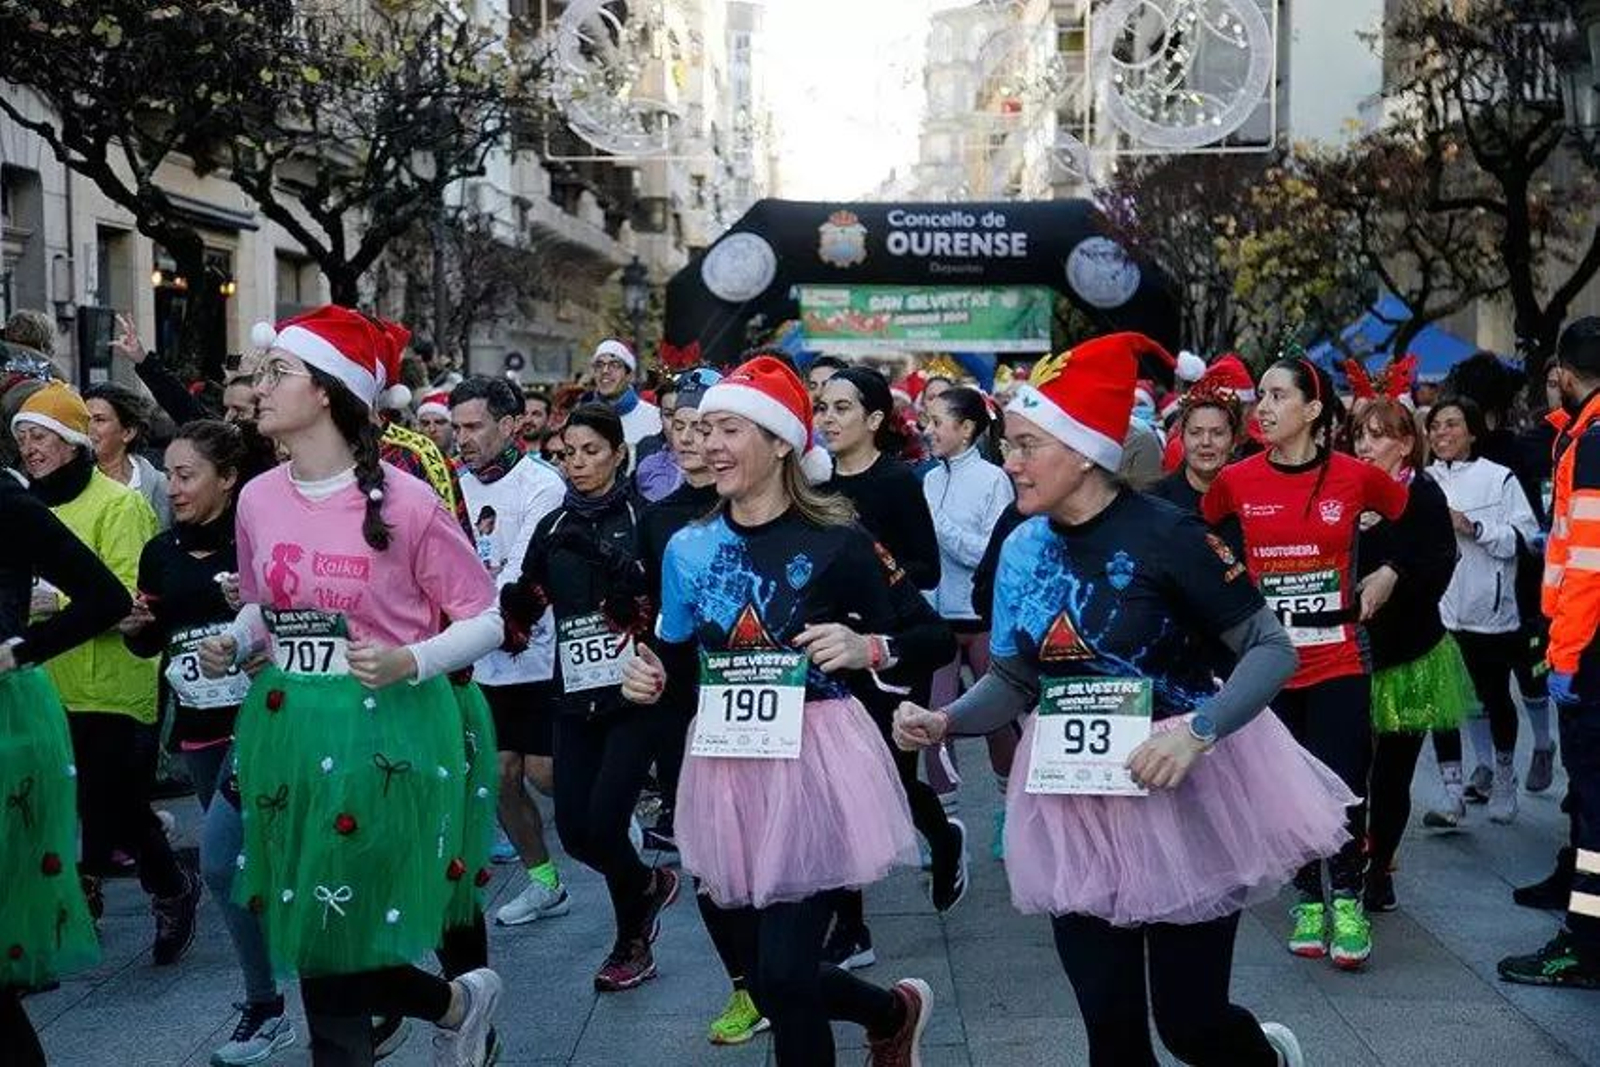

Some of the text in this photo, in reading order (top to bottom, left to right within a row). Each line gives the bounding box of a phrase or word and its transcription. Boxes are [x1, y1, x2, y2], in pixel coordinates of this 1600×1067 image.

[887, 209, 1005, 228] Concello de
[886, 232, 1028, 257] OURENSE
[279, 640, 335, 673] 707
[569, 637, 620, 665] 365
[707, 653, 801, 669] SAN SILVESTRE
[1066, 681, 1143, 696] SILVESTRE
[721, 688, 779, 722] 190
[1064, 718, 1112, 755] 93
